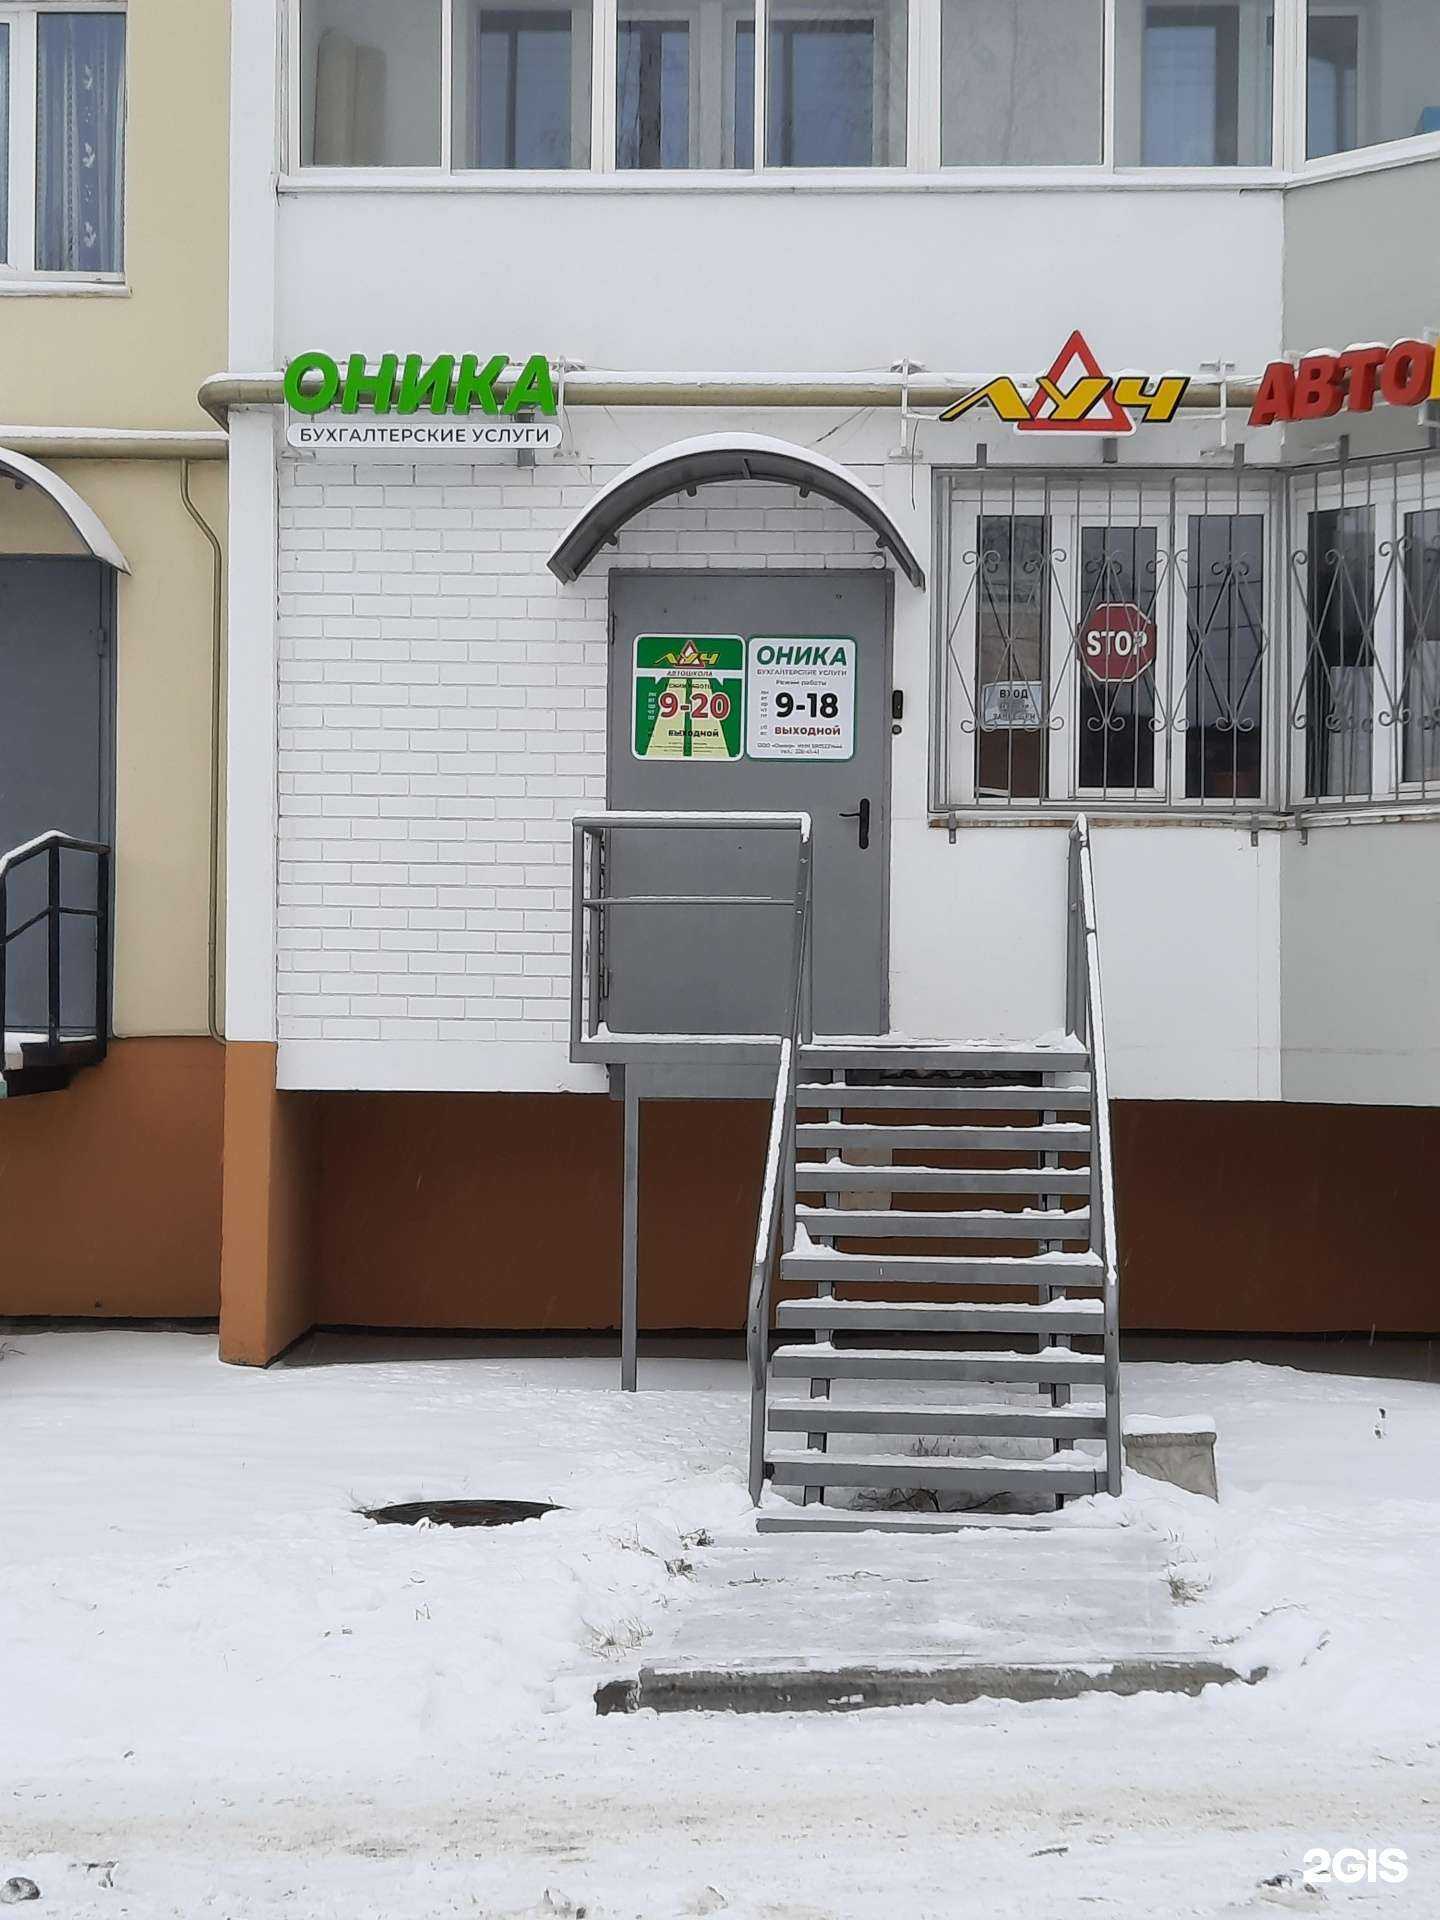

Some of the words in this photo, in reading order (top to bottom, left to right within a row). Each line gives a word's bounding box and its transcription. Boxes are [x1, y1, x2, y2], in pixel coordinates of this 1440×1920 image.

[284, 352, 557, 416] ОНИКА
[1247, 337, 1440, 427] АВТО
[939, 376, 1191, 423] ЛУЧ
[300, 428, 466, 442] БУХГАЛТЕРСКИЕ
[472, 428, 549, 442] УСЛУГИ
[757, 646, 847, 666] ОНИКА
[1087, 630, 1147, 656] STOP
[660, 693, 730, 719] 9-20
[775, 692, 839, 718] 9-18
